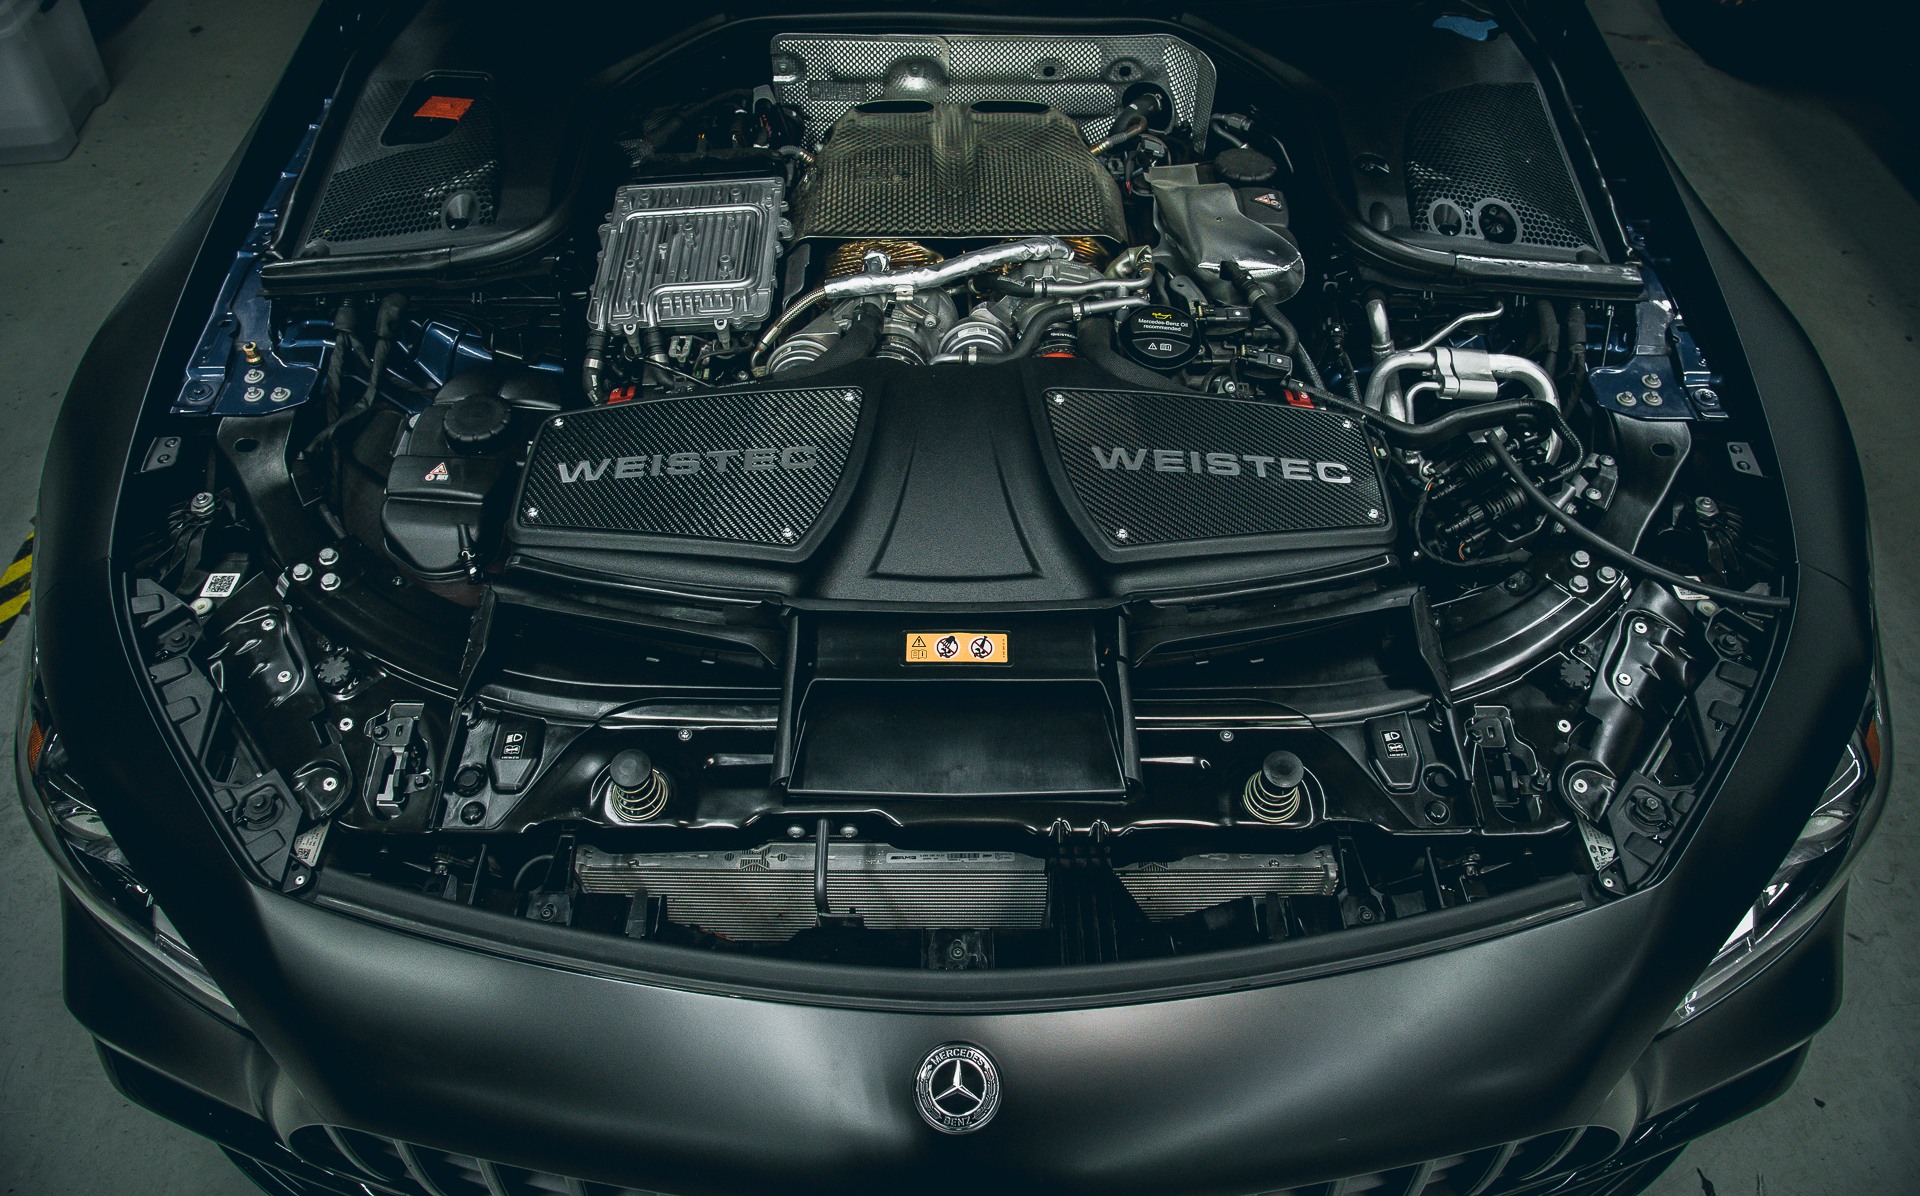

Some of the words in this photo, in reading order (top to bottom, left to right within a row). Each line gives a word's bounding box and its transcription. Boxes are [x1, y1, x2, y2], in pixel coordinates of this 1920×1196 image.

[1137, 318, 1180, 327] Mercedes-Benz
[1143, 324, 1182, 332] recommended
[557, 446, 817, 484] WEISTEC
[1091, 445, 1351, 484] WEISTEC
[930, 1048, 984, 1066] MERCEDES
[943, 1115, 973, 1127] BENZ
